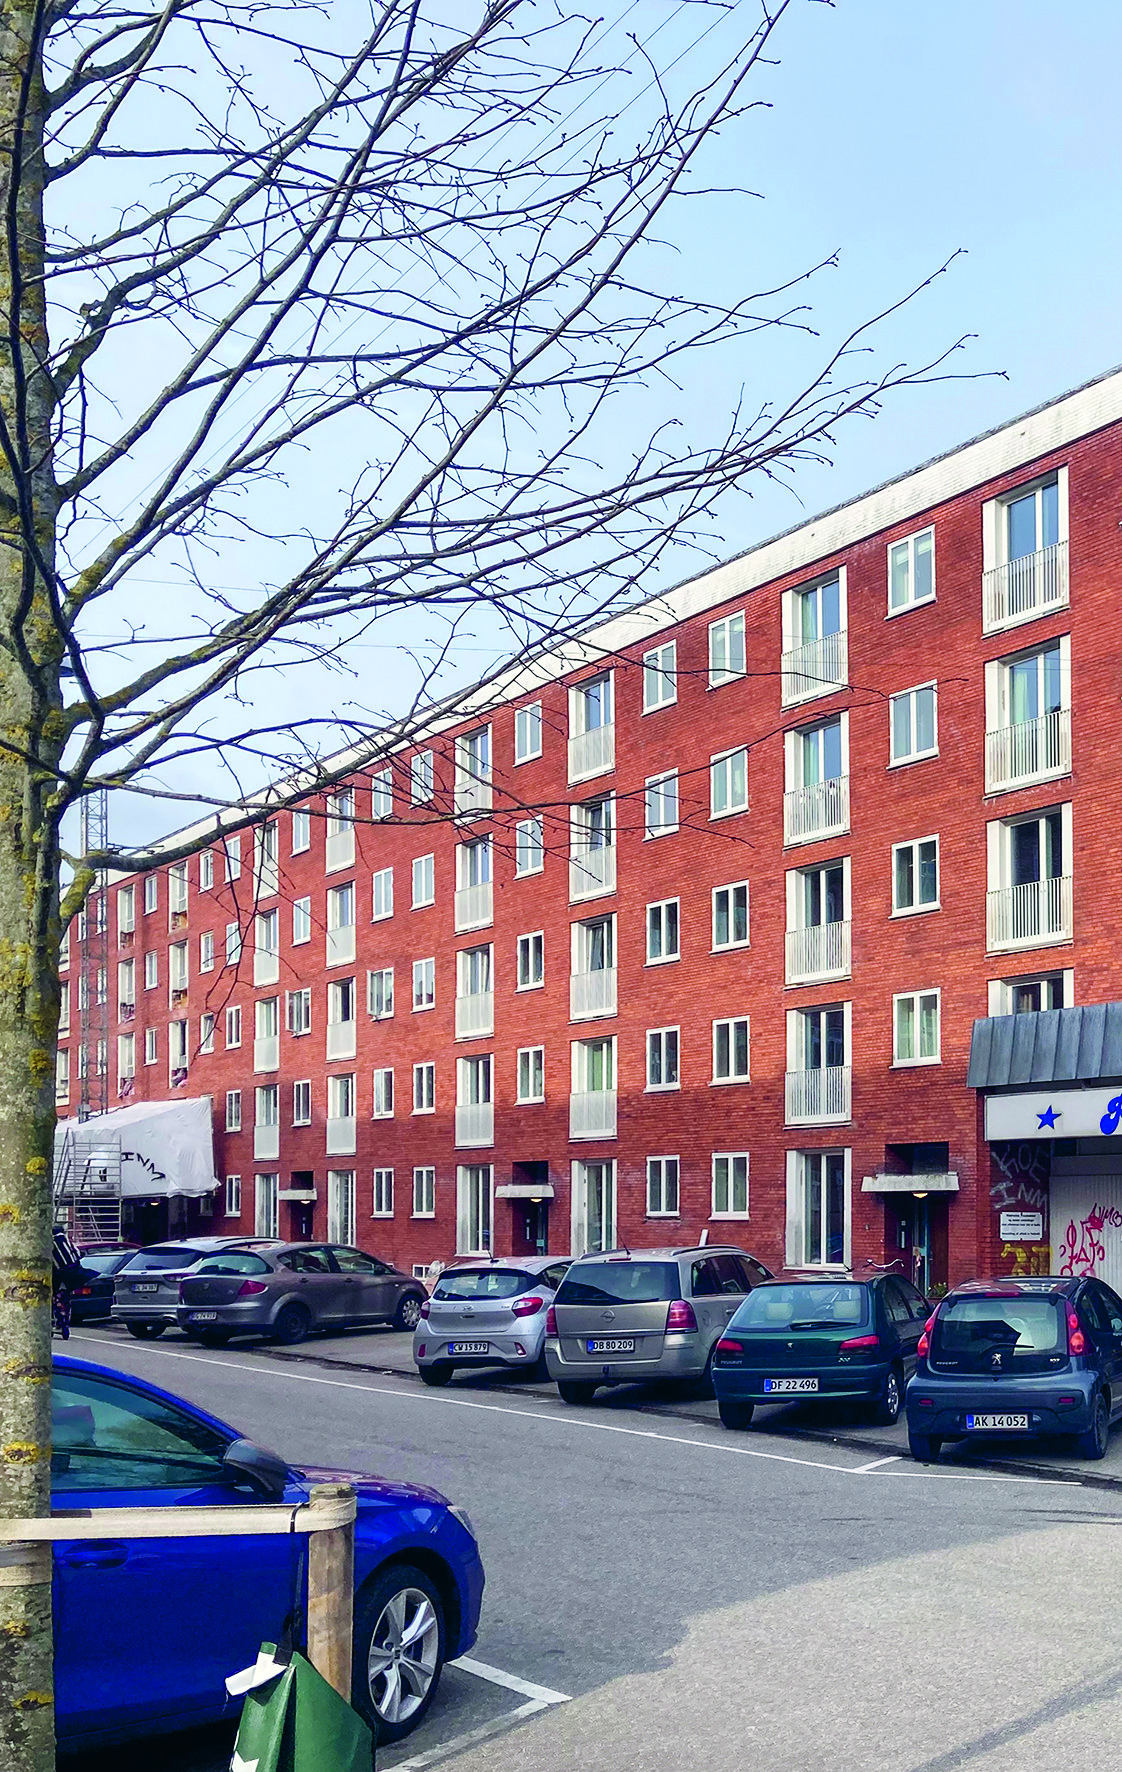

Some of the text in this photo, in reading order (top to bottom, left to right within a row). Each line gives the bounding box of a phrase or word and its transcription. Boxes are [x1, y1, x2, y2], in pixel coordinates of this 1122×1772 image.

[464, 1343, 473, 1351] 15
[474, 1342, 487, 1351] 879
[594, 1340, 633, 1350] DB 80 209
[770, 1379, 817, 1390] DF 22 496
[974, 1416, 1026, 1427] AK 14 052
